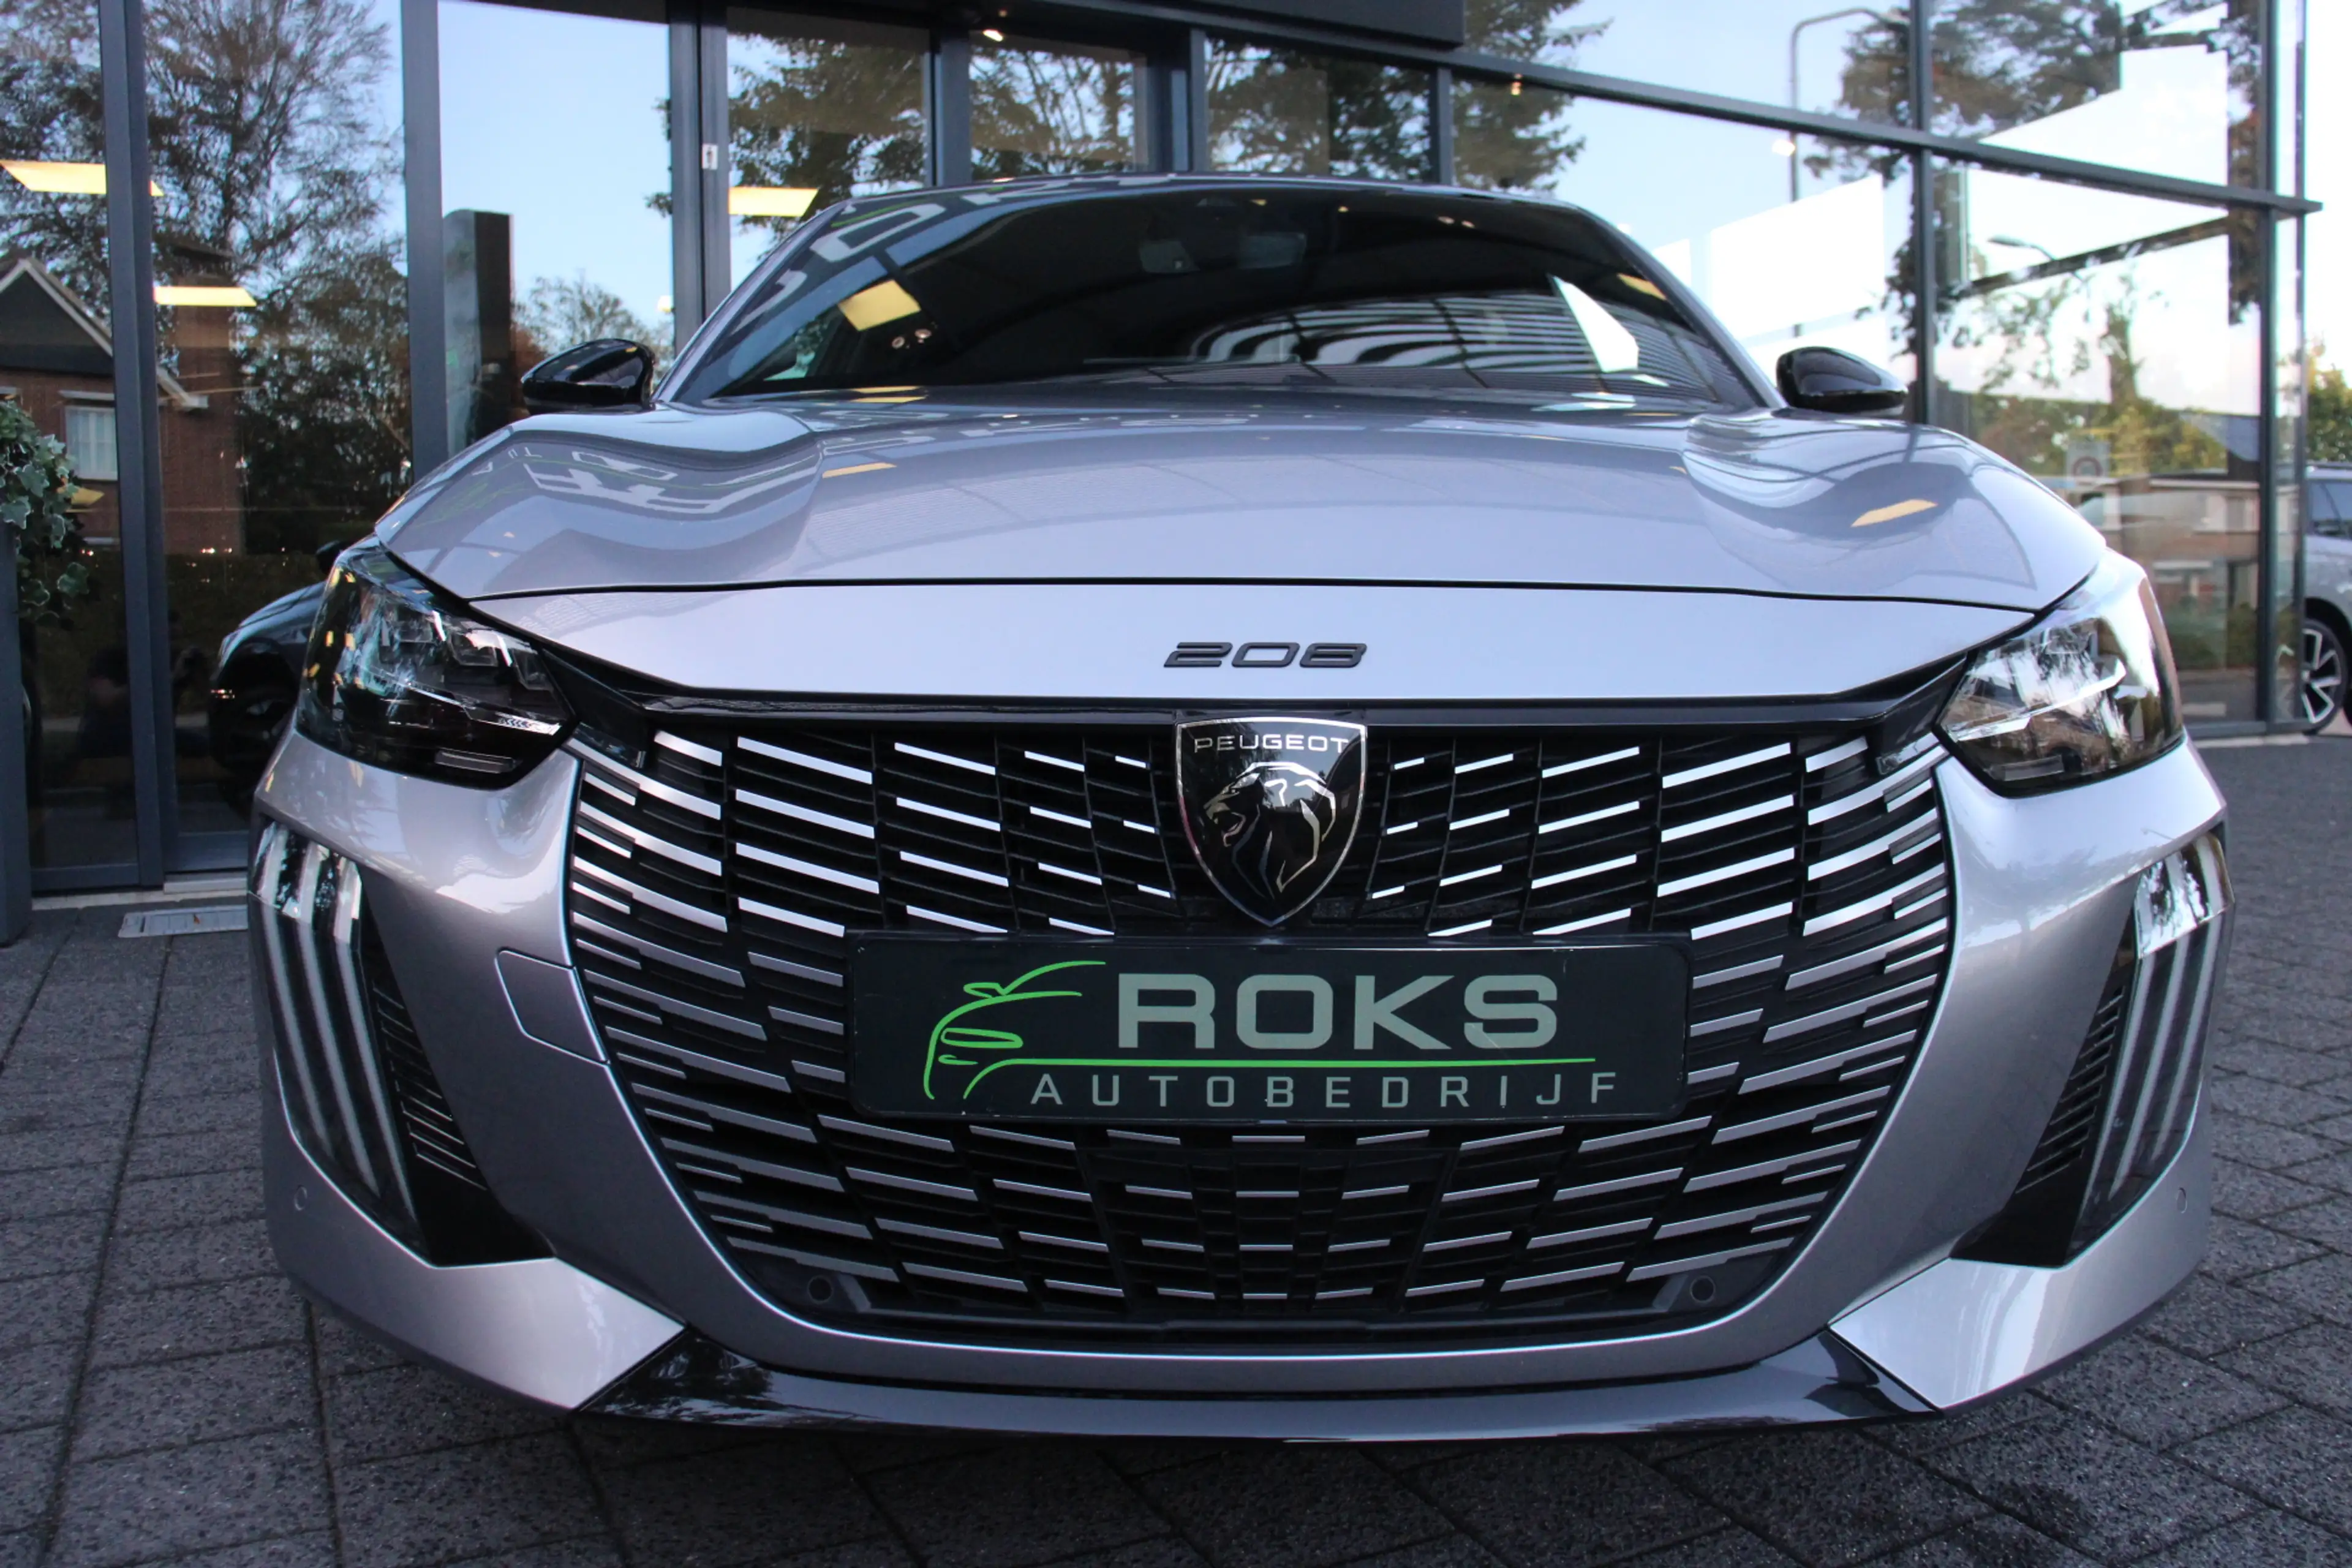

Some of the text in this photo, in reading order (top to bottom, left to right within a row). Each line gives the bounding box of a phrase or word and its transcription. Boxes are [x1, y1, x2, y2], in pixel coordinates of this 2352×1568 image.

[1164, 642, 1368, 668] 208
[1194, 734, 1349, 753] PEUGEOT
[1118, 973, 1558, 1050] ROKS
[1031, 1072, 1616, 1107] AUTOBEDRIJF
